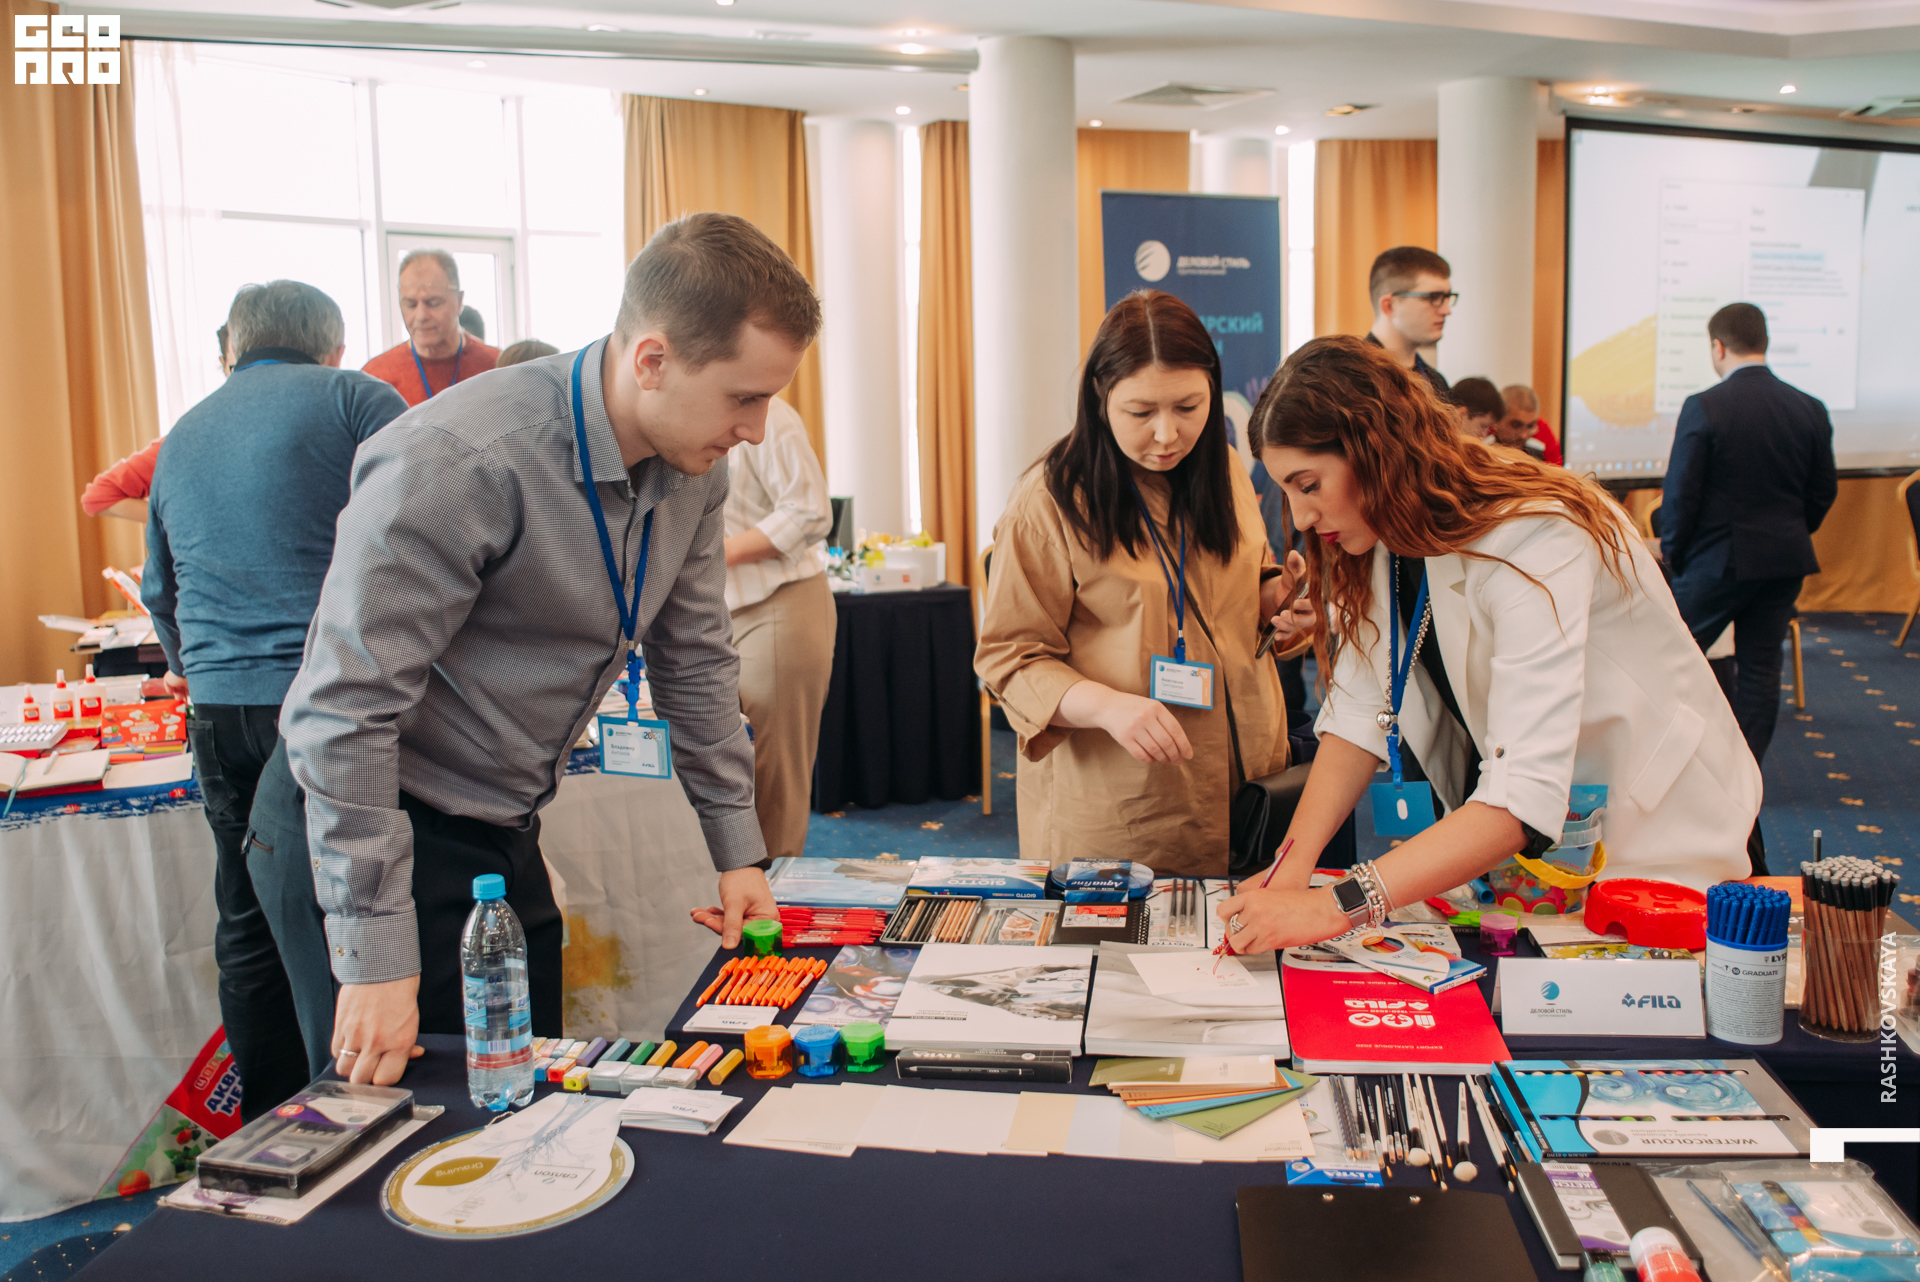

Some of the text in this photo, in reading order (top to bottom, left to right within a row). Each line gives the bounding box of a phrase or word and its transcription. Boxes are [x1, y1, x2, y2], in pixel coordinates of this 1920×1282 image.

[1070, 880, 1124, 889] Aquafine
[1771, 952, 1787, 963] LYR
[1344, 1000, 1407, 1009] FILA
[1637, 994, 1682, 1009] FILA
[912, 1050, 953, 1059] LYRA
[1639, 1137, 1759, 1145] WATERCOLOUR
[435, 1161, 484, 1178] Drawing
[1322, 1169, 1365, 1178] LYRA
[1553, 1179, 1598, 1189] SKETCH
